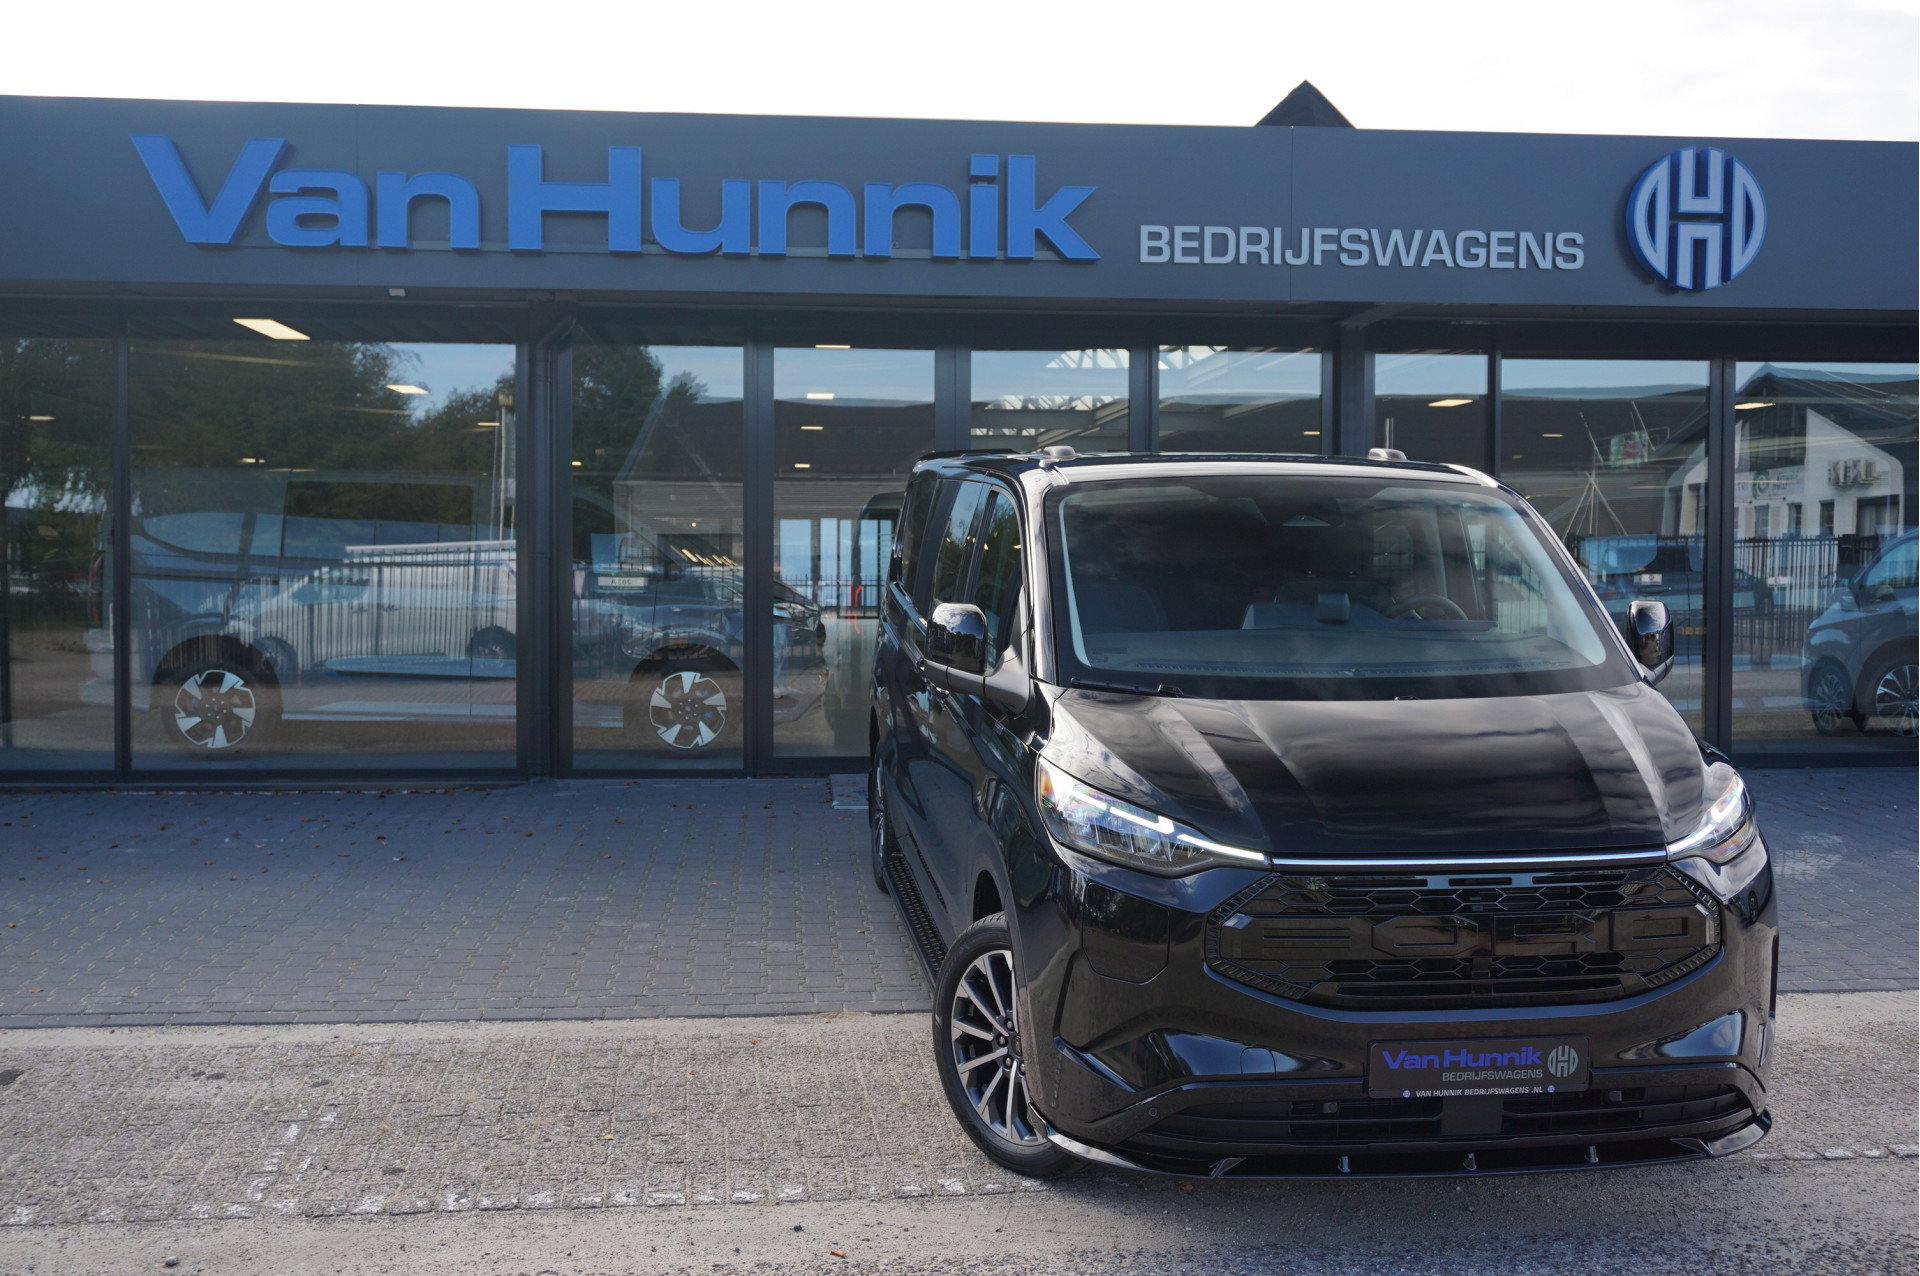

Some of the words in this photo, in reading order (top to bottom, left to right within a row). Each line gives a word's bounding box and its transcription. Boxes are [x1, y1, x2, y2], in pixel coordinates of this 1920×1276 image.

[129, 133, 482, 250] Van
[506, 143, 1102, 261] Hunnik
[1139, 223, 1586, 271] BEDRIJFSWAGENS
[1382, 1050, 1440, 1070] Van
[1443, 1047, 1543, 1068] Hunnik
[1442, 1069, 1543, 1082] BEDRIJFSWAGENS
[1415, 1090, 1432, 1098] VAN
[1433, 1089, 1463, 1097] HUNNIK
[1464, 1086, 1530, 1096] BEDRIJFSWAGENS
